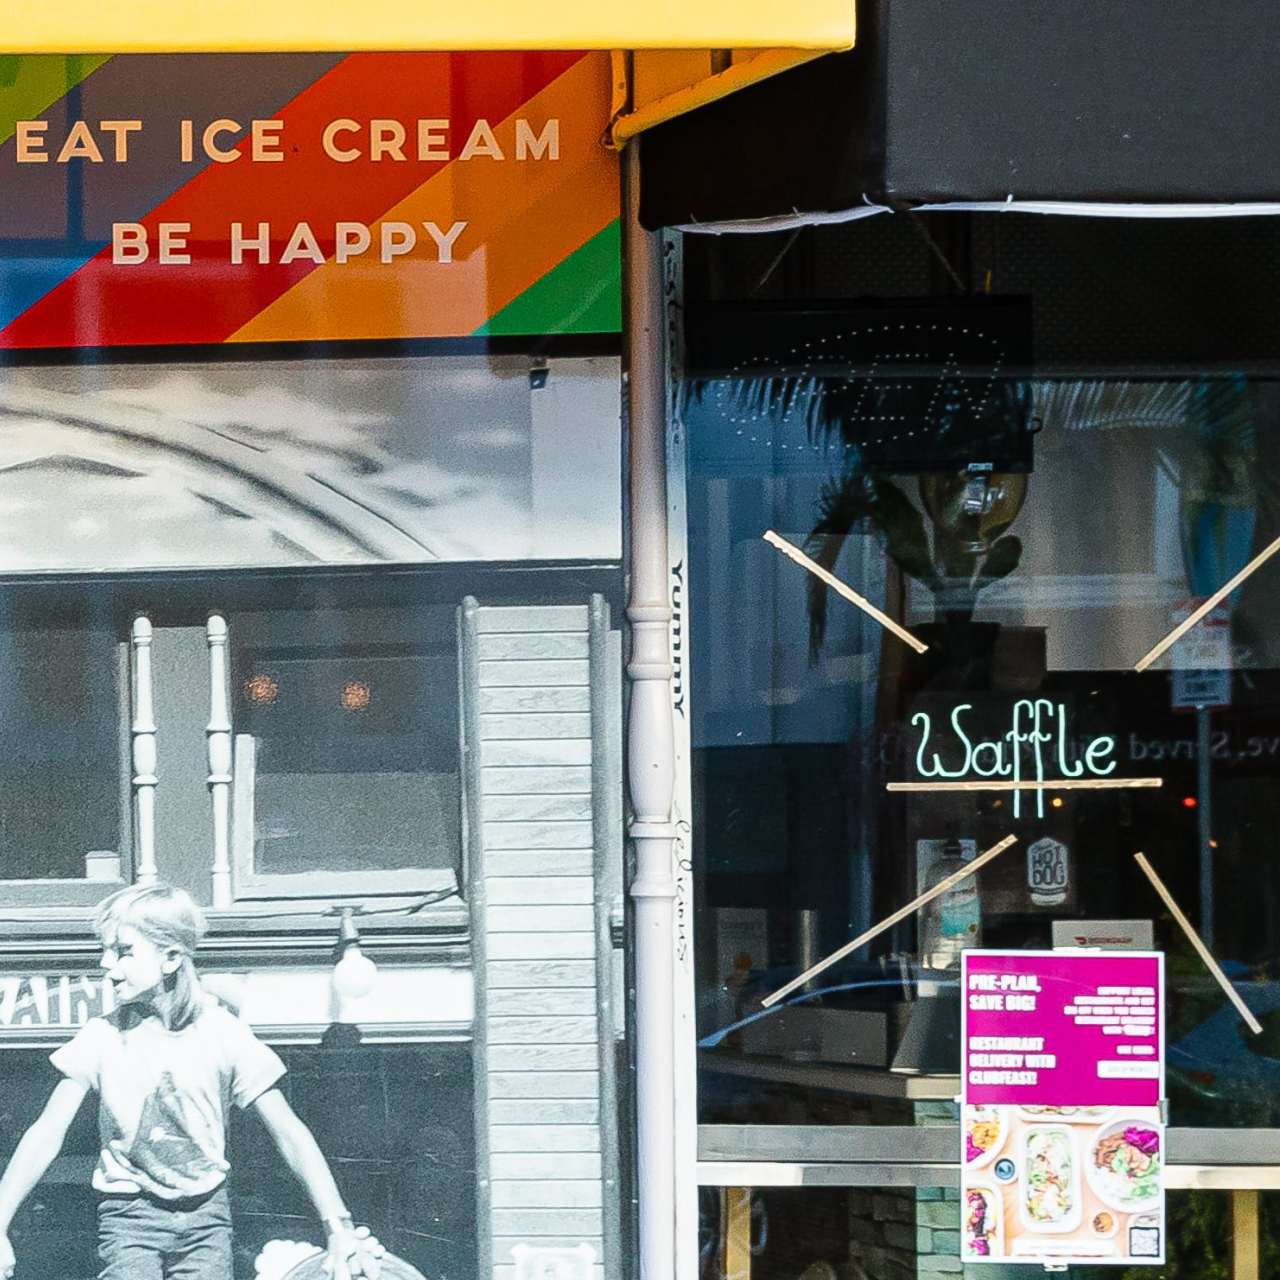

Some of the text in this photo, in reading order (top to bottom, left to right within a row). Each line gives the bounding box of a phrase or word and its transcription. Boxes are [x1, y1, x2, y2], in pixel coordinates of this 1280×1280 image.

[15, 119, 564, 162] EAT ICE CREAM
[112, 222, 468, 265] BE HAPPY
[911, 698, 1118, 819] Waffle
[969, 995, 1004, 1010] SAVE
